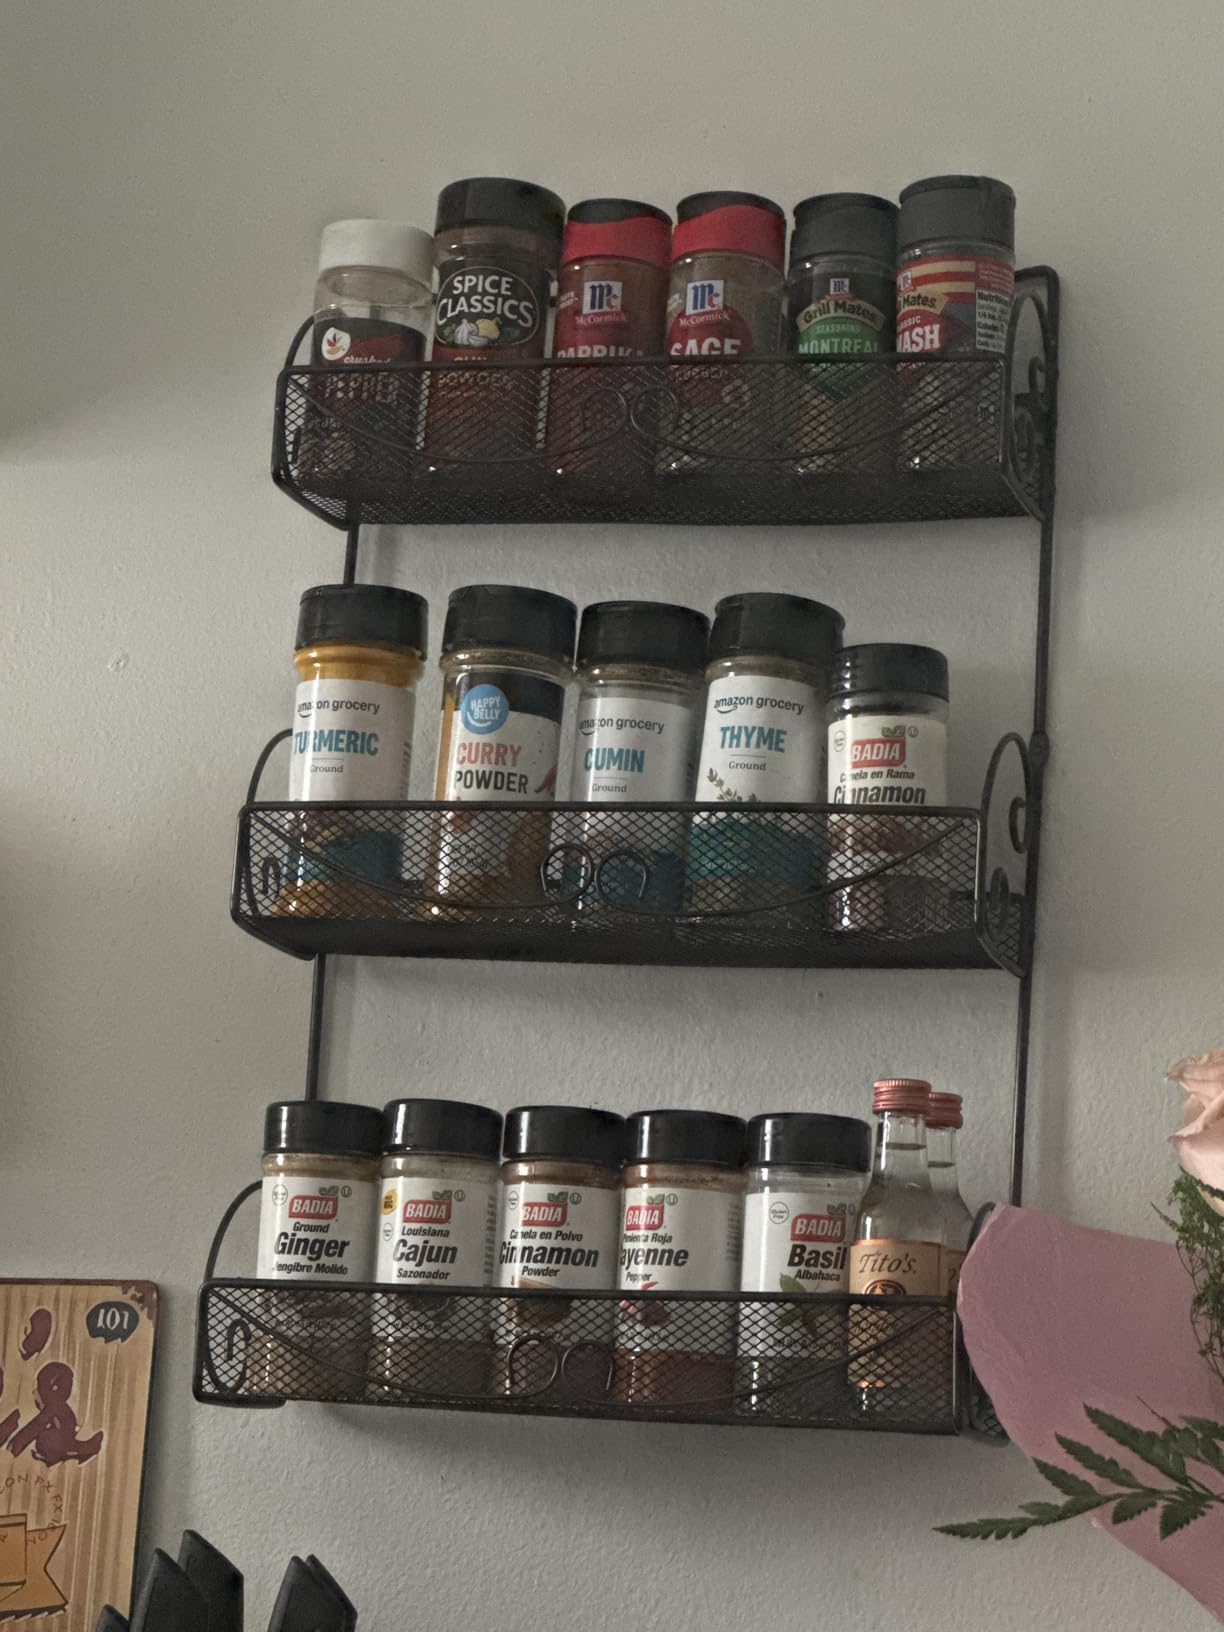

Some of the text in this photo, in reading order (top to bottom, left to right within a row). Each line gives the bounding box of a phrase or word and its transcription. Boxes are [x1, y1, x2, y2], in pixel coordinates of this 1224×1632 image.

[452, 275, 513, 295] SPICE
[902, 293, 937, 309] Mates
[437, 295, 534, 328] CLASSICS
[576, 313, 627, 327] McCormick
[679, 311, 731, 327] McCormick
[803, 301, 830, 323] Grill
[834, 301, 878, 322] Mates
[332, 700, 380, 715] grocery
[471, 696, 502, 711] HAPPY
[714, 696, 804, 715] amazon grocery
[473, 709, 502, 721] BELLY
[616, 718, 665, 735] grocery
[720, 725, 787, 753] THYME
[456, 742, 522, 767] CURRY
[584, 747, 645, 773] CUMIN
[852, 742, 900, 762] BADIA
[728, 760, 766, 771] Ground
[870, 770, 883, 780] en
[886, 768, 915, 780] Rama
[455, 769, 529, 795] POWDER
[592, 783, 627, 793] Ground
[292, 1199, 334, 1215] BADIA
[406, 1203, 447, 1220] BADIA
[523, 1206, 562, 1223] BADIA
[627, 1208, 660, 1225] BADIA
[293, 1221, 330, 1233] Ground
[401, 1225, 450, 1238] Louisiana
[795, 1217, 842, 1237] BADIA
[539, 1231, 551, 1241] en
[554, 1230, 583, 1243] Polvo
[651, 1232, 674, 1246] Roja
[274, 1231, 350, 1262] Ginger
[393, 1238, 458, 1267] Cajun
[500, 1241, 599, 1268] Cinnamon
[620, 1246, 689, 1271] ayenne
[787, 1243, 848, 1270] Basil
[314, 1264, 348, 1277] Molido
[396, 1267, 451, 1281] Sazonador
[521, 1265, 560, 1278] Powder
[794, 1268, 841, 1282] Albahaca
[97, 1307, 129, 1330] 101
